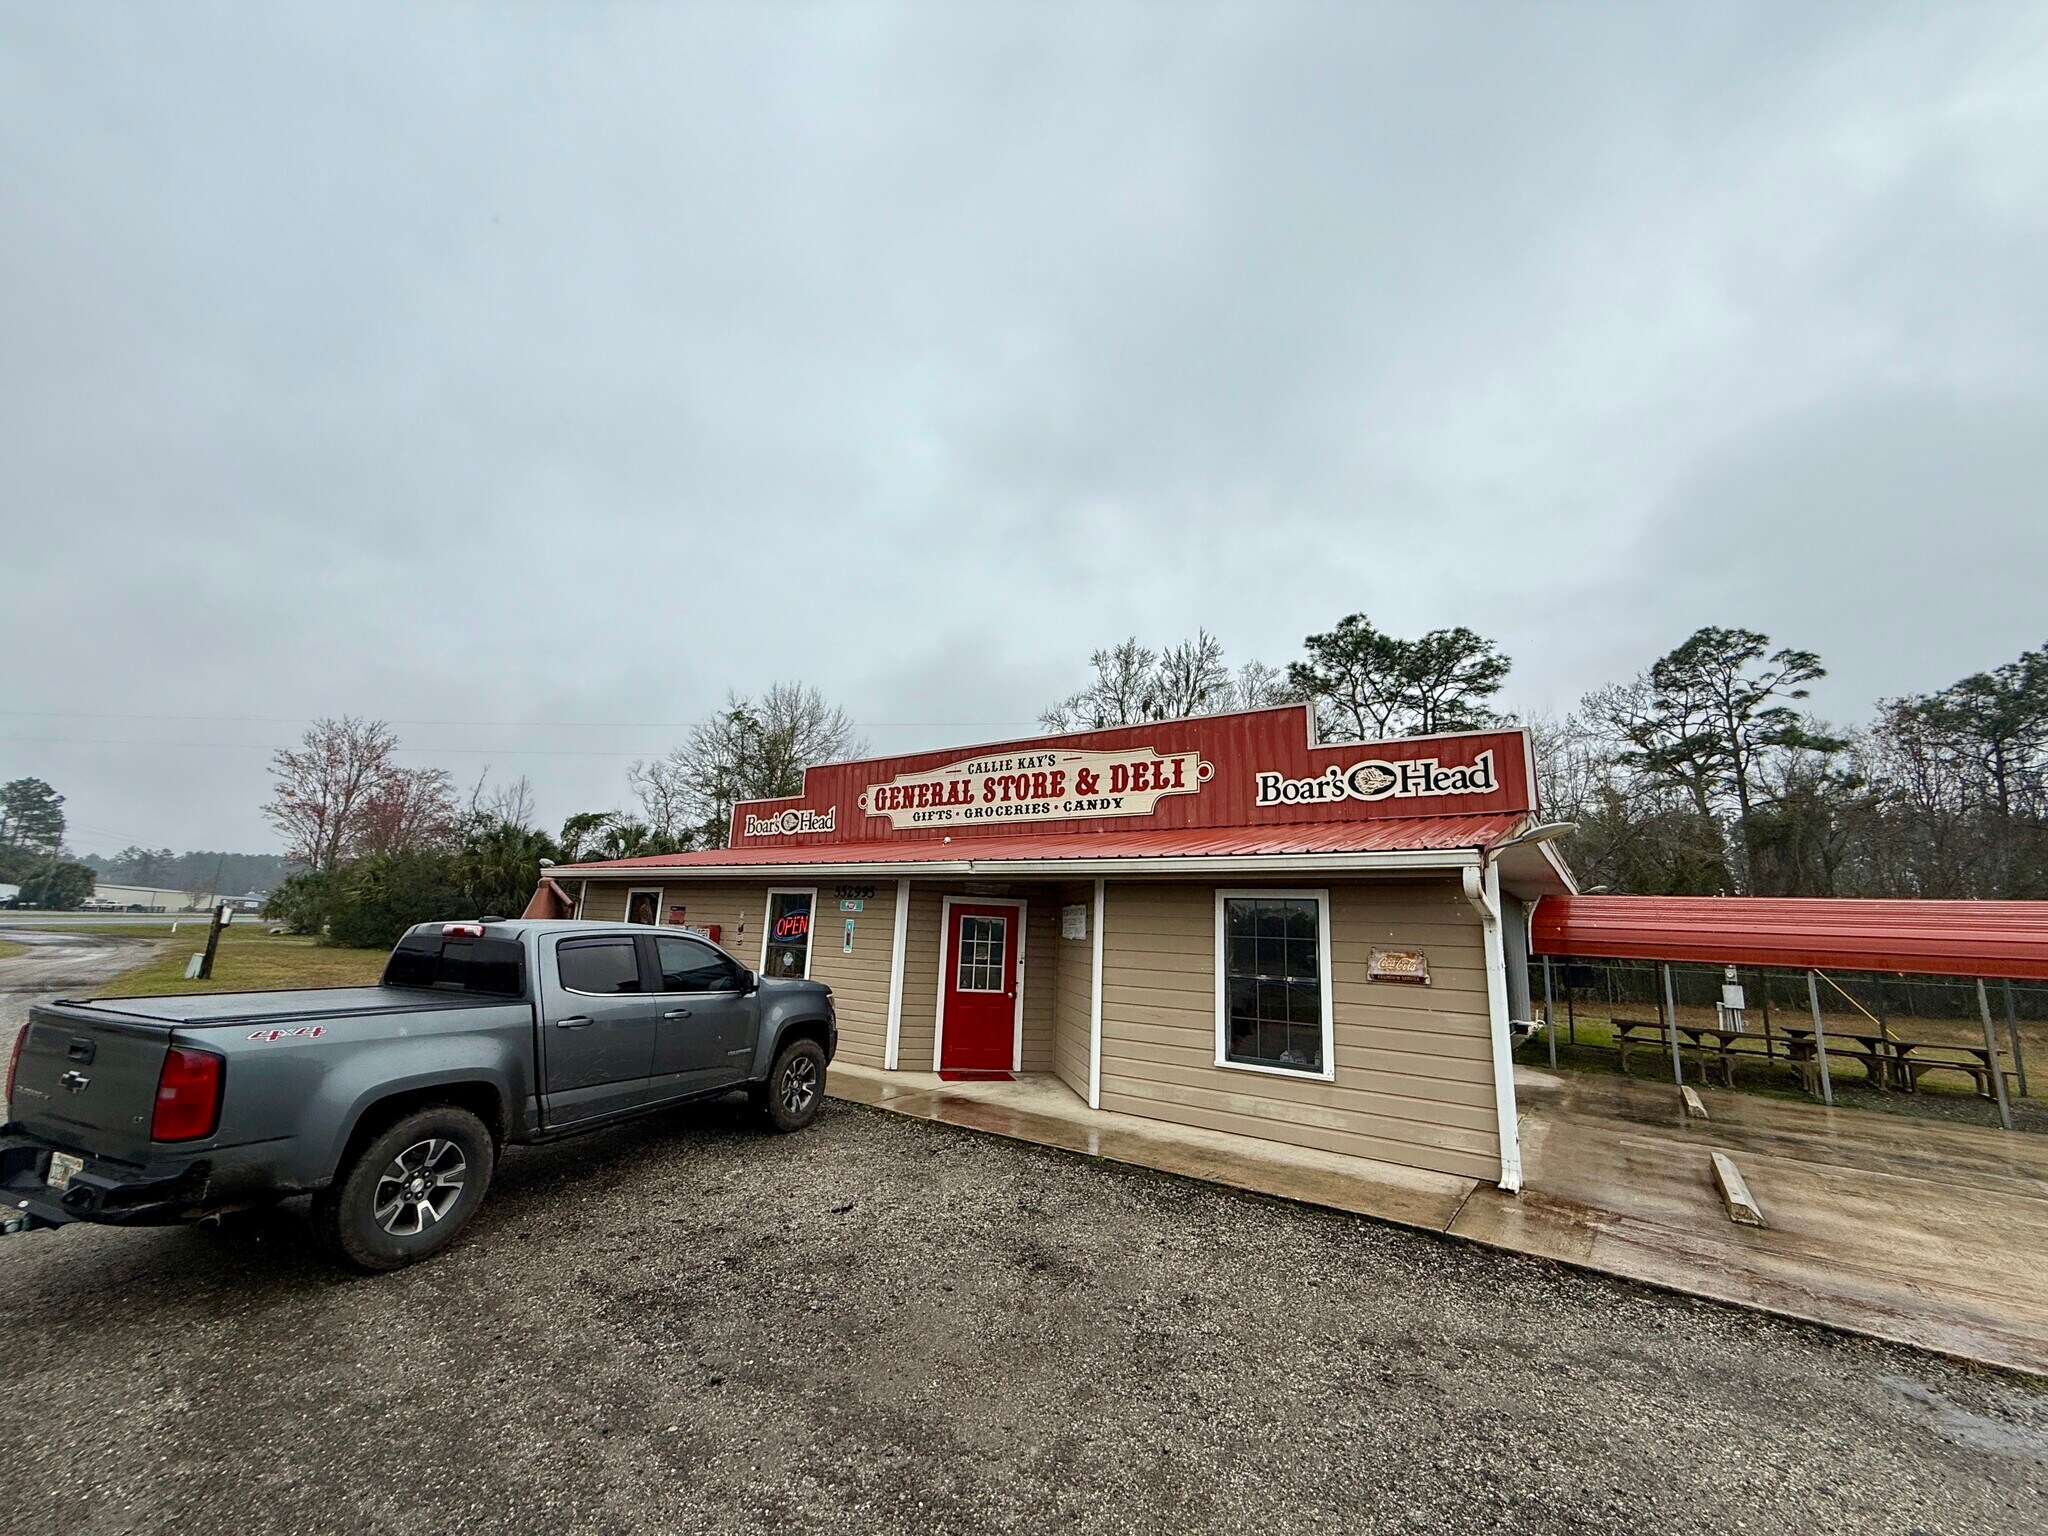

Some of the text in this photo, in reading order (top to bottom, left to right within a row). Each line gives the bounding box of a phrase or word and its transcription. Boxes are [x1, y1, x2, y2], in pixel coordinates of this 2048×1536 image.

[967, 754, 1056, 775] CALLIE KAY'S
[874, 758, 1185, 811] GENERAL STORE & DELI
[1258, 755, 1494, 802] Boar's Head
[746, 809, 834, 834] Boar's Head
[913, 797, 1124, 822] GIFTS GROCERIES CANDY
[776, 915, 809, 936] OPEN
